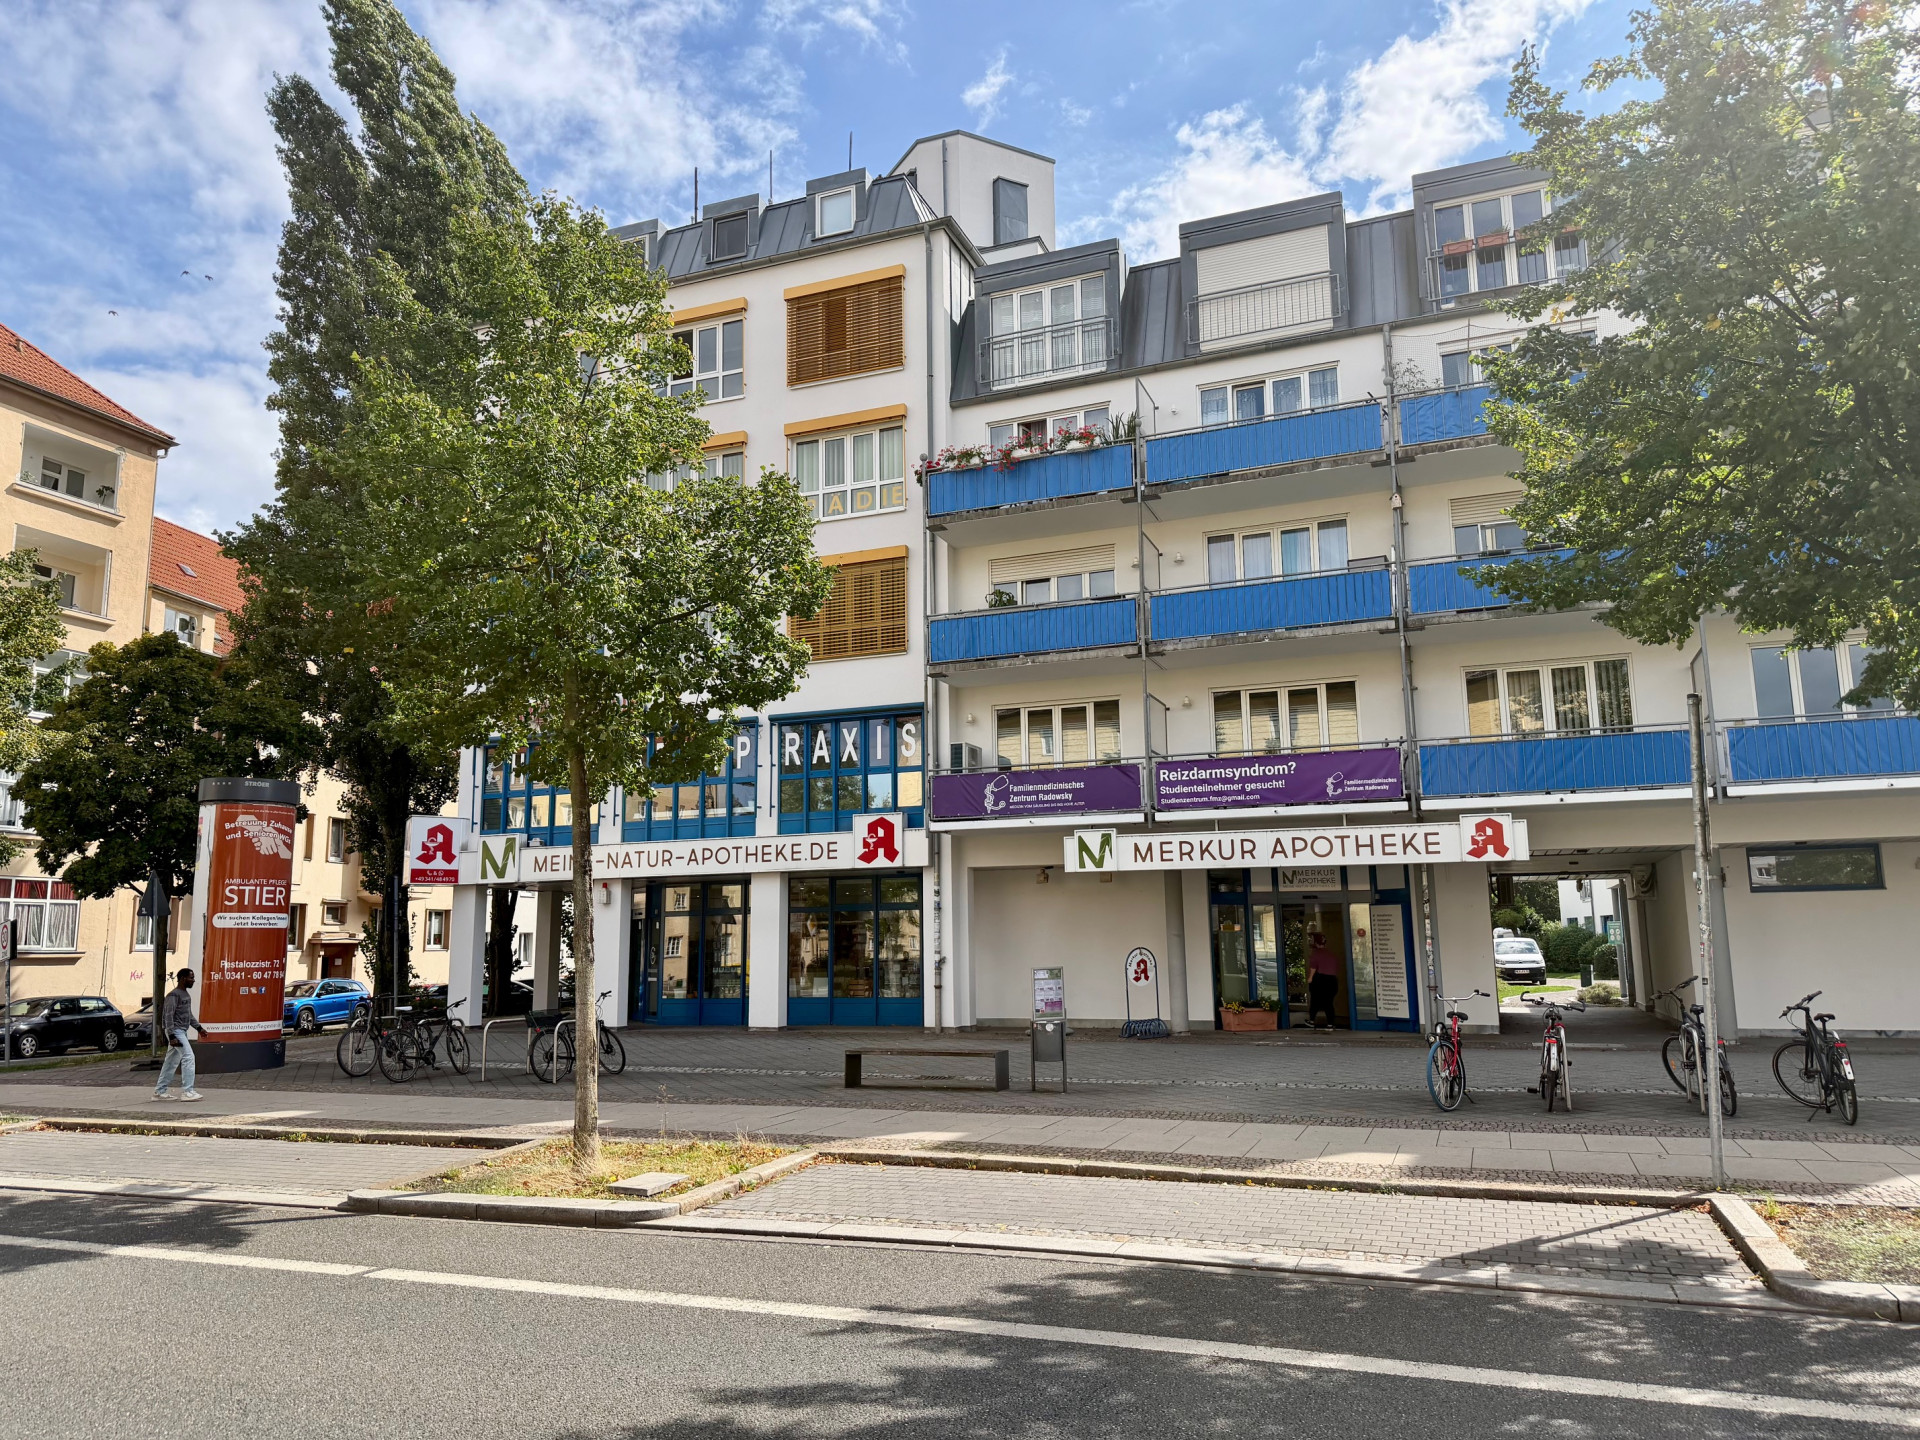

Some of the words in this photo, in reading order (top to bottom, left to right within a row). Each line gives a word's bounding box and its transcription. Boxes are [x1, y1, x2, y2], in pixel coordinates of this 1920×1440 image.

[735, 721, 917, 770] PRAXIS
[1159, 761, 1297, 782] Reizdarmsyndrom?
[1009, 781, 1085, 792] Familienmedizinisches
[1343, 777, 1397, 786] Familienmedizinisches
[1160, 783, 1242, 795] Studienteilnehmer
[1244, 780, 1286, 792] gesucht!
[1009, 794, 1037, 803] Zentrum
[1038, 791, 1073, 802] Radowsky
[1160, 794, 1260, 805] Studienzentrum.fmz@gmail.com
[224, 820, 268, 830] Betreuung
[269, 820, 293, 834] Zuhause
[225, 831, 242, 841] und
[243, 830, 279, 839] Senioren
[1133, 838, 1256, 863] MERKUR
[1270, 831, 1441, 859] APOTHEKE
[1297, 869, 1336, 877] MERKUR
[223, 885, 286, 906] STIER
[220, 959, 272, 969] Pestalozzistr.
[273, 959, 280, 968] 72
[210, 971, 224, 981] Tel.
[225, 971, 245, 980] 0341
[252, 971, 262, 980] 60
[263, 971, 272, 980] 47
